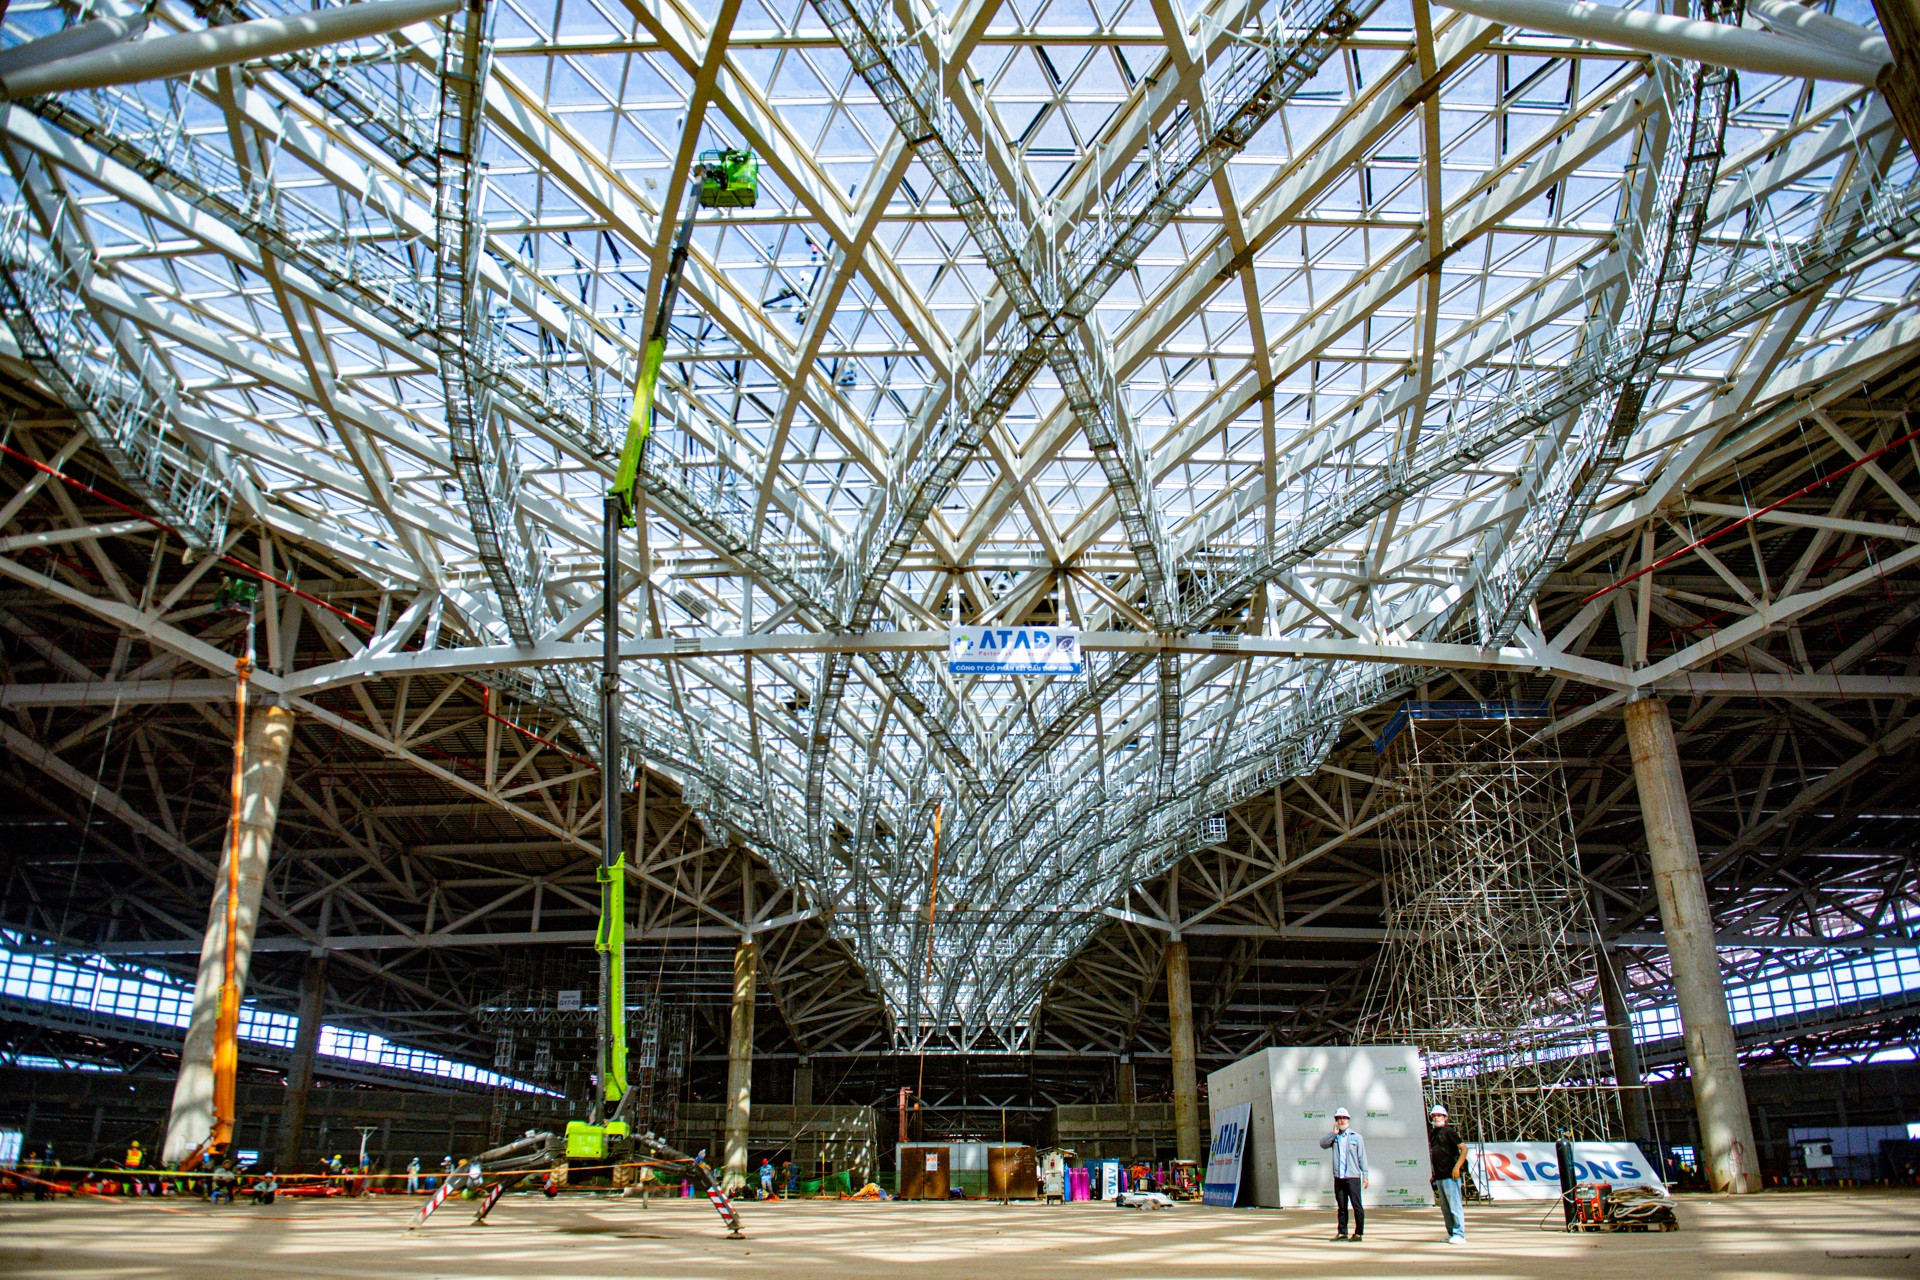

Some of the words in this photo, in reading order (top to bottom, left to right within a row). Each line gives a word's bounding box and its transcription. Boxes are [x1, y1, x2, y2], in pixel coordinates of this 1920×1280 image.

[979, 630, 1050, 648] ATAD
[1216, 1122, 1237, 1155] ATAD
[1108, 1168, 1116, 1196] ATAD
